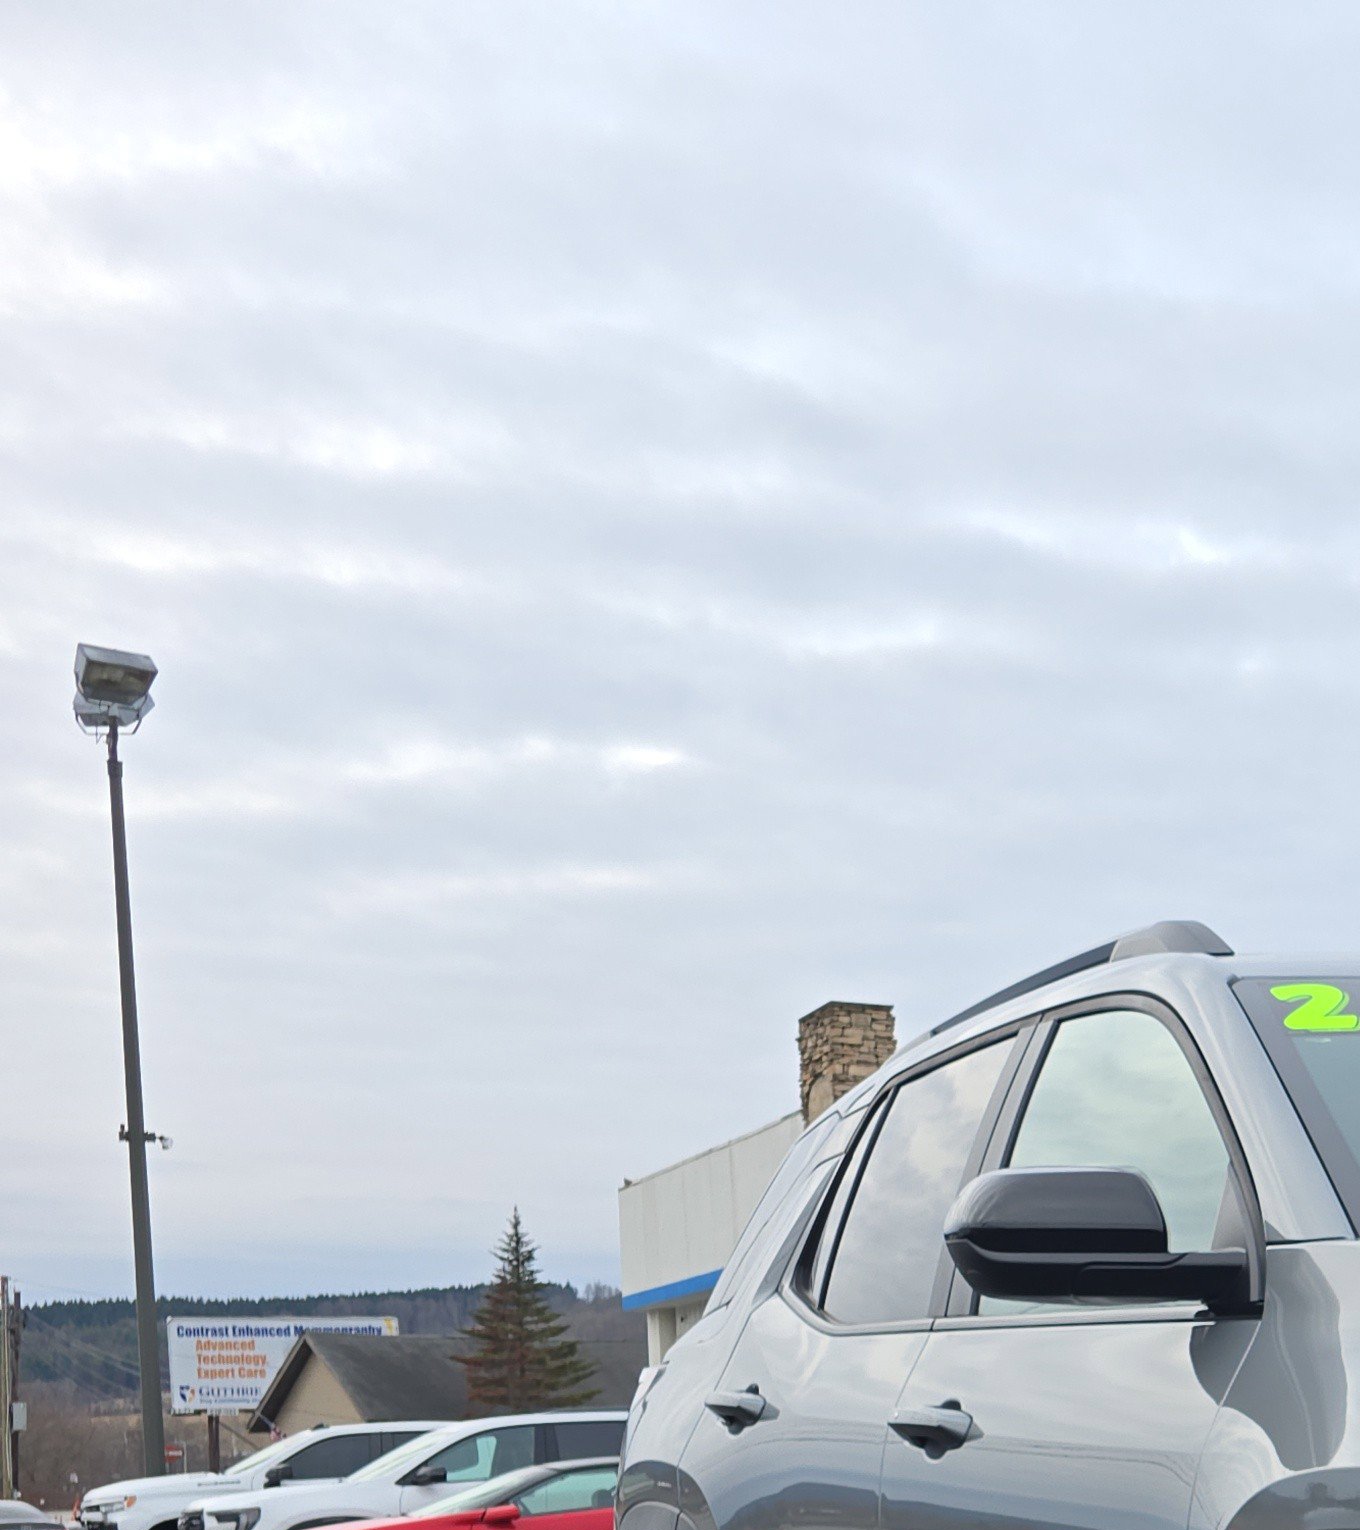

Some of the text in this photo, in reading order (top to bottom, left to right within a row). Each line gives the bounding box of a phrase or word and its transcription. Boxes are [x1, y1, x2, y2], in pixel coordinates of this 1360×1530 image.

[177, 1325, 230, 1338] Contrast
[232, 1324, 291, 1337] Enhanced
[195, 1339, 256, 1351] Advanced
[197, 1367, 267, 1380] Expert Care
